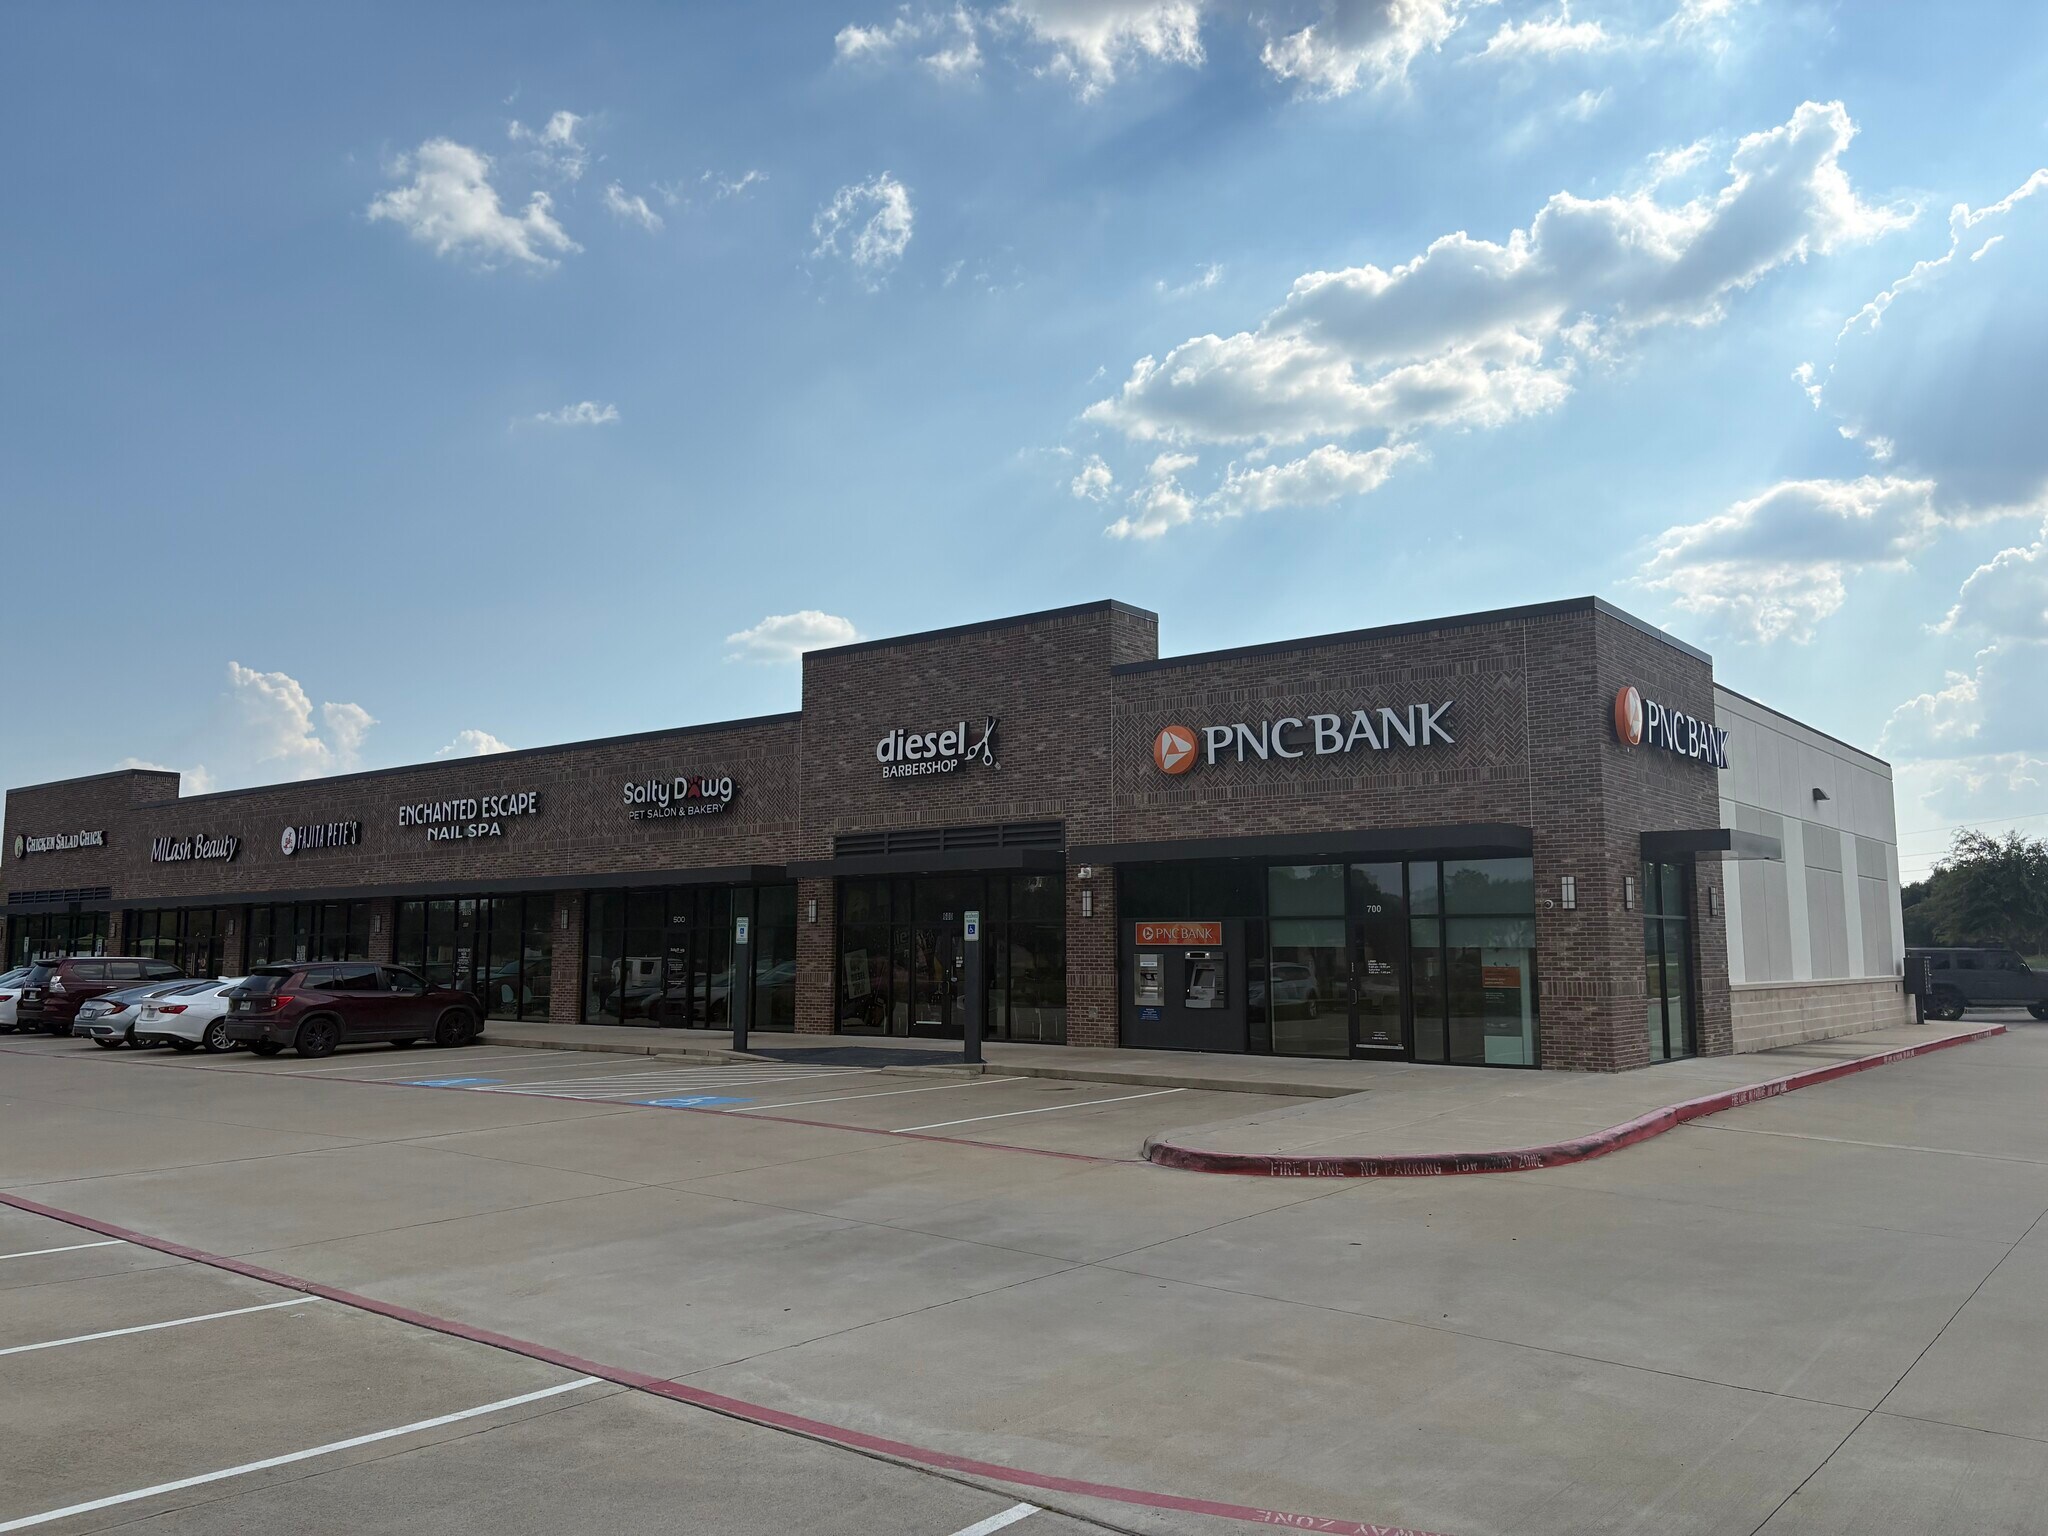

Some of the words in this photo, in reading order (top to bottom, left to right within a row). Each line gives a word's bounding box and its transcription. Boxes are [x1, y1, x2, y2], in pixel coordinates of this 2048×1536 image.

[876, 721, 966, 763] diesel
[1201, 717, 1304, 765] PNC
[1308, 700, 1456, 754] BANK
[1645, 699, 1686, 754] PNC
[1686, 715, 1730, 769] BANK
[882, 759, 958, 778] BARBERSHOP
[623, 780, 670, 807] Salty
[399, 798, 478, 826] ENCHANTED
[482, 792, 537, 818] ESCAPE
[629, 809, 645, 820] PET
[647, 807, 677, 818] SALON
[679, 806, 686, 816] &
[687, 803, 726, 816] BAKERY
[297, 826, 324, 849] FAJITA
[327, 821, 357, 846] PETE'S
[427, 824, 463, 841] NAIL
[468, 822, 502, 838] SPA
[195, 834, 237, 862] Beauty
[673, 915, 686, 924] 500
[1366, 904, 1382, 913] 700
[1156, 928, 1180, 939] PNC
[1182, 928, 1213, 939] BANK
[1270, 1161, 1301, 1176] FIRE
[1307, 1161, 1344, 1176] LANE
[1360, 1161, 1378, 1176] NO
[1385, 1161, 1442, 1176] PARKING
[1519, 1153, 1544, 1169] ZONE
[1252, 1509, 1336, 1528] ZONE
